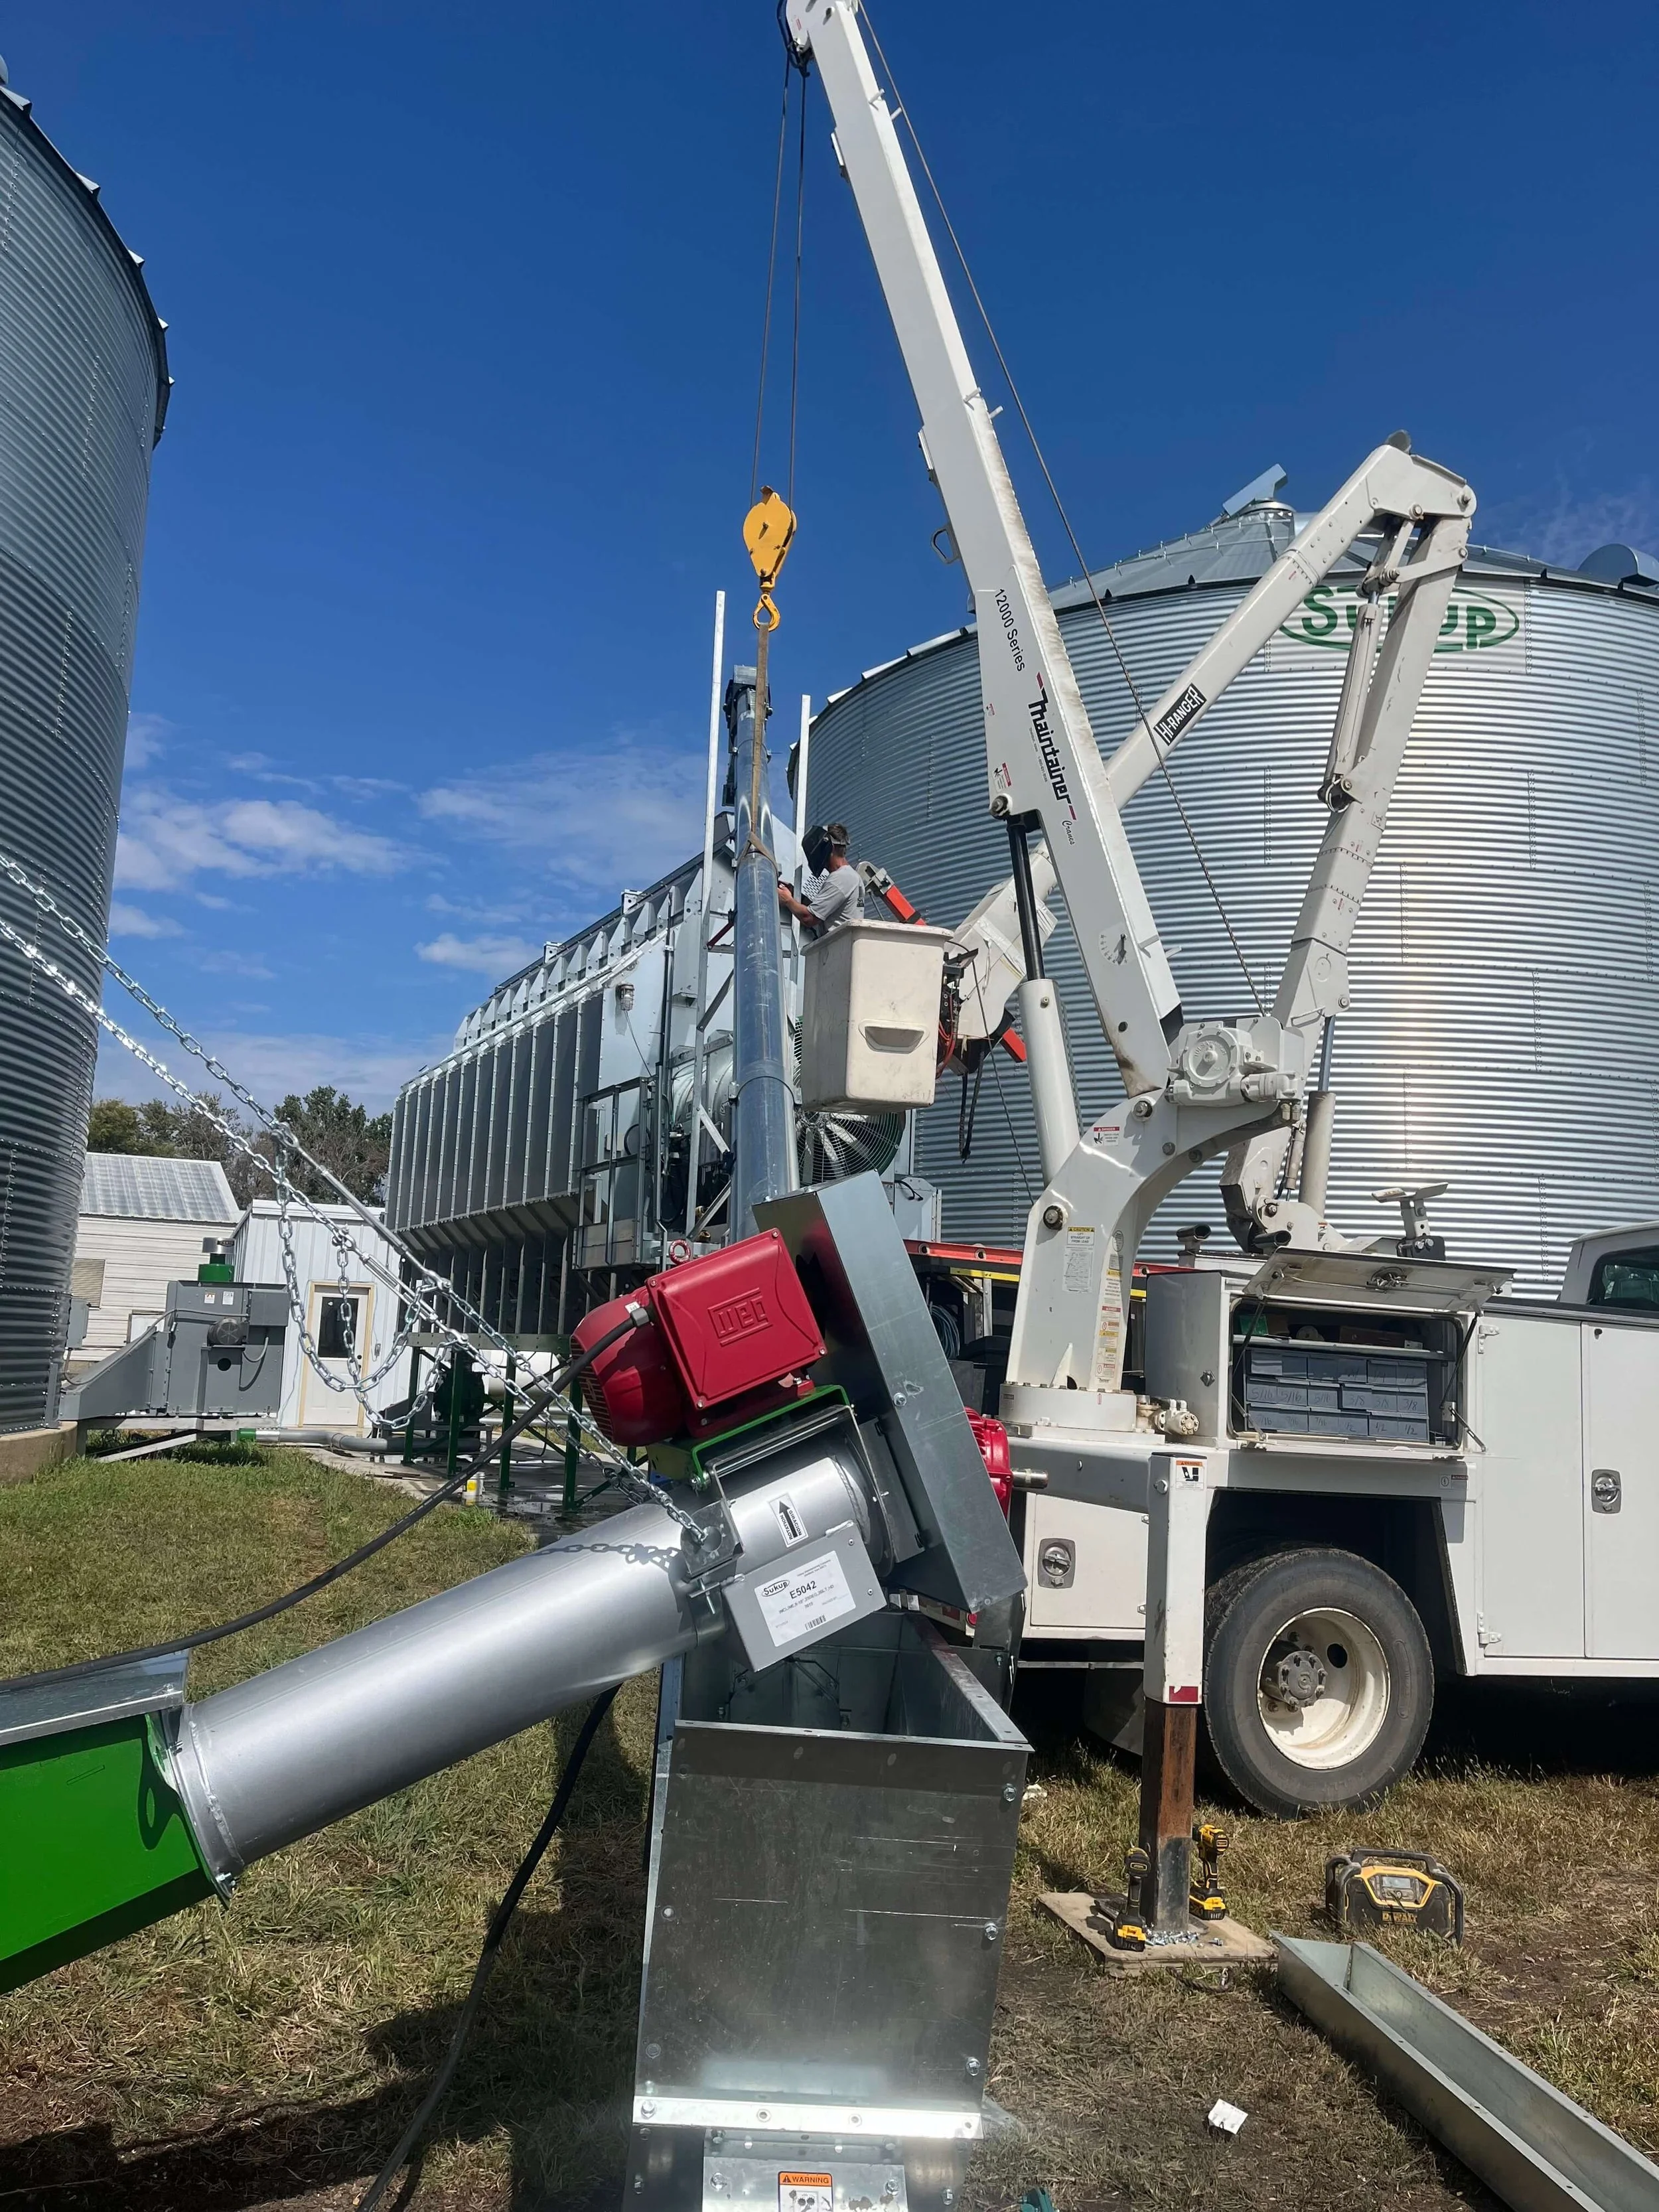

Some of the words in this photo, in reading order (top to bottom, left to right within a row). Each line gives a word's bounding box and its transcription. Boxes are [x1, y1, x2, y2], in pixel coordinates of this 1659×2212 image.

[995, 589, 1014, 628] 12000
[1007, 628, 1025, 672] Series
[1155, 686, 1204, 743] HI-RANGER
[1029, 687, 1072, 804] Maintainer
[1062, 820, 1075, 846] Cranes
[1403, 1398, 1418, 1410] 3/8
[780, 1514, 793, 1540] ROTATION
[764, 1581, 788, 1595] Sukup
[790, 1580, 817, 1599] E5042
